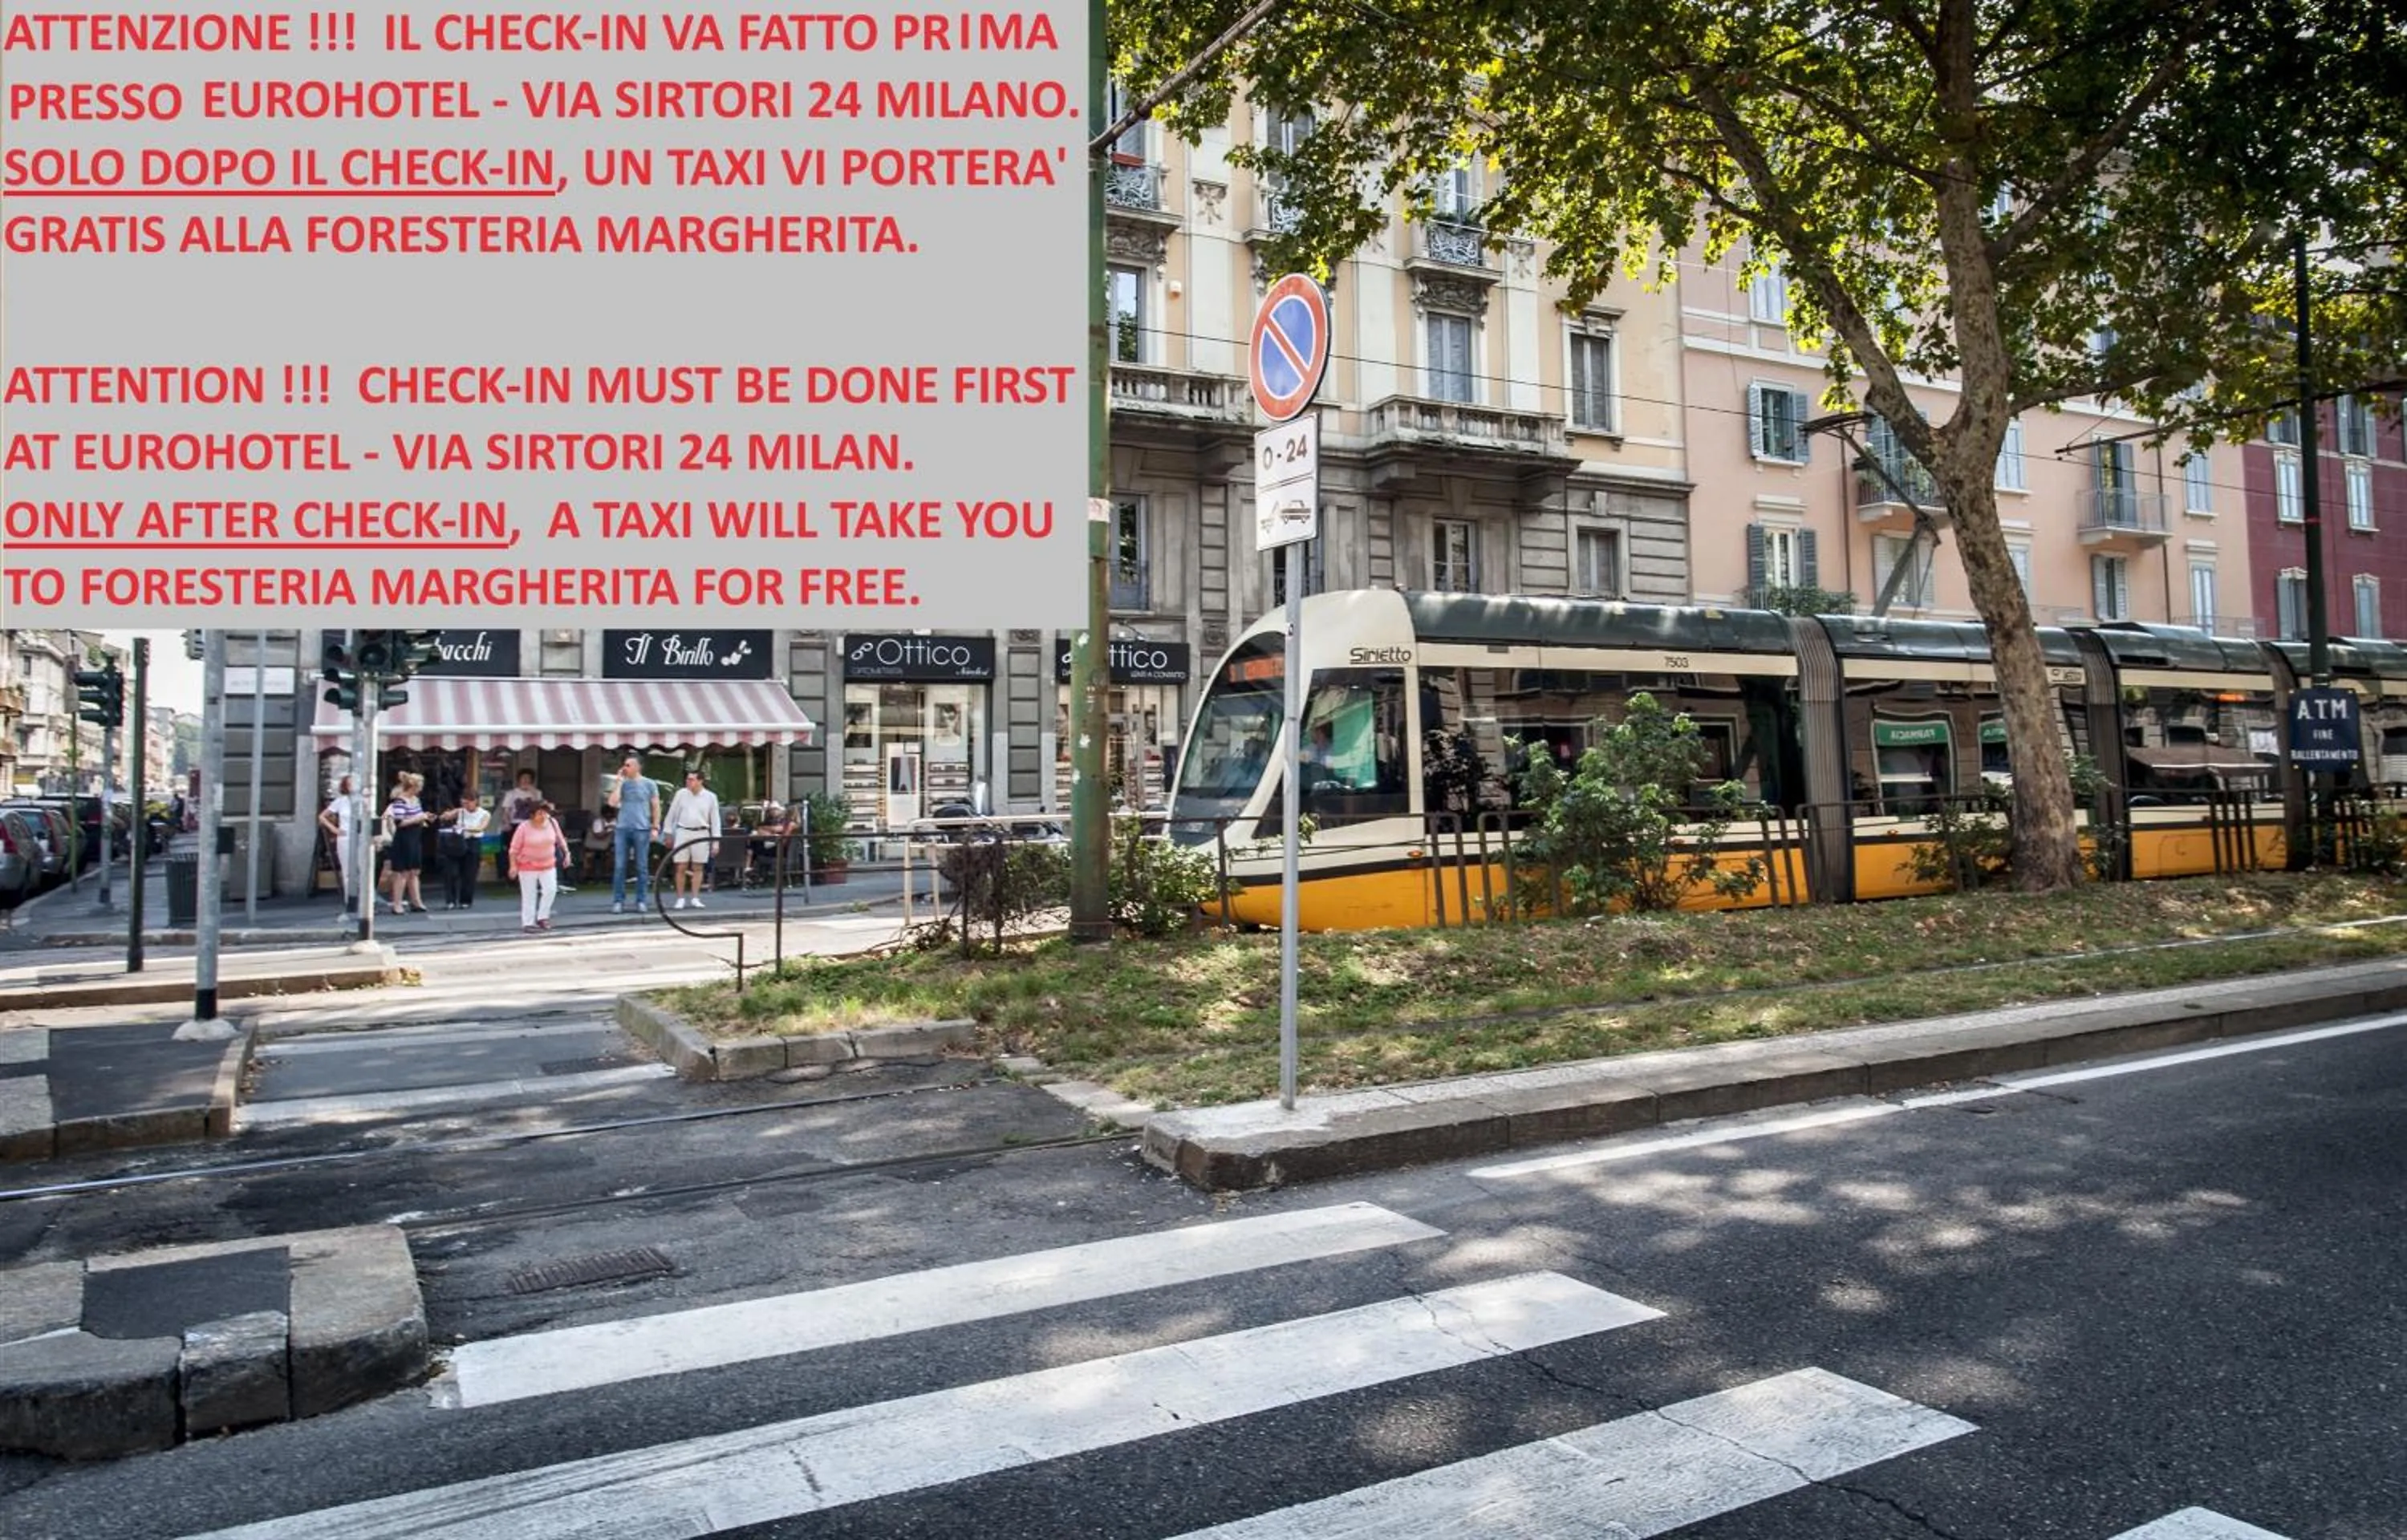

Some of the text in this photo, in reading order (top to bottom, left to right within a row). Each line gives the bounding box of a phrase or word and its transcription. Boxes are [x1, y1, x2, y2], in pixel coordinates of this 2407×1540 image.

[1286, 434, 1308, 463] 24
[625, 633, 714, 667] Il Birillo
[876, 638, 970, 665] Ottico
[1108, 644, 1168, 669] ttico
[1665, 656, 1689, 668] 7503
[2312, 728, 2334, 740] FINE
